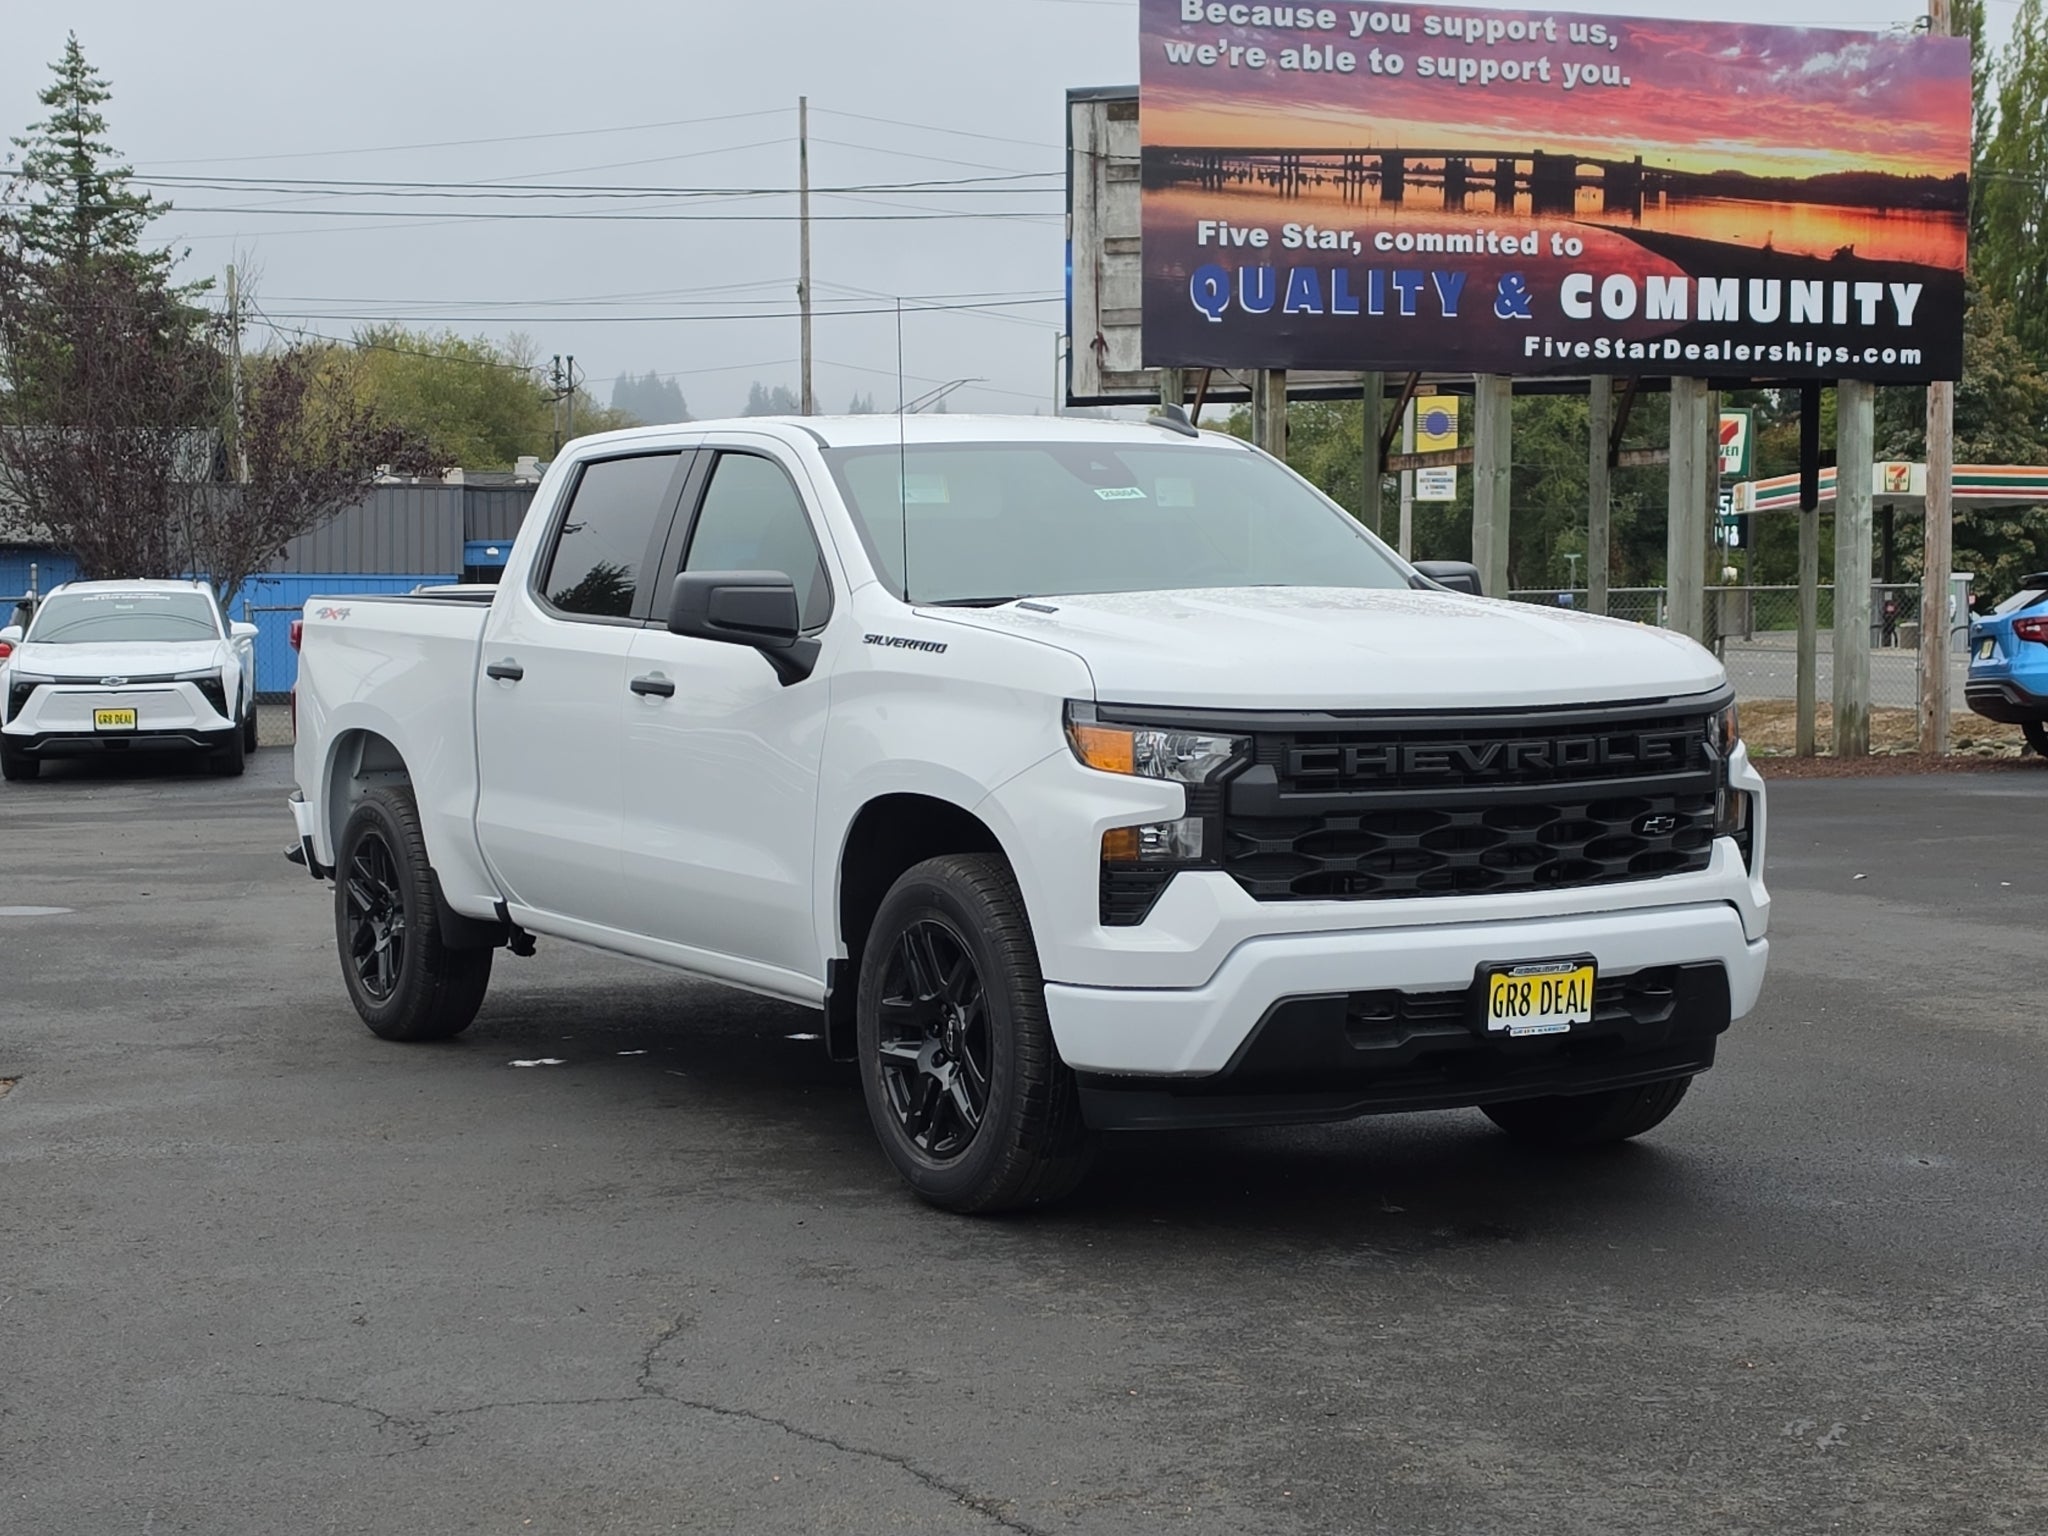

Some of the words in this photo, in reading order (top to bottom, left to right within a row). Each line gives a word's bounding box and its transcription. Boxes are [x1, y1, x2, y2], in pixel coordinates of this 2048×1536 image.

[1181, 0, 1337, 30] Because
[1349, 11, 1411, 38] you
[1423, 16, 1556, 45] support
[1569, 22, 1618, 50] us,
[1164, 39, 1267, 67] we're
[1279, 43, 1357, 73] able
[1368, 47, 1405, 75] to
[1416, 55, 1551, 85] support
[1562, 61, 1631, 90] you.
[1198, 220, 1270, 248] Five
[1281, 222, 1362, 256] Star,
[1374, 228, 1539, 256] commited
[1550, 231, 1584, 257] to
[1190, 264, 1467, 322] QUALITY
[1494, 271, 1533, 319] &
[1560, 273, 1923, 326] COMMUNITY
[1524, 336, 1921, 367] FiveStarDealerships.com
[862, 634, 948, 654] SILVERADO
[1290, 729, 1704, 777] CHEVROLET
[1493, 982, 1531, 1018] GR8
[1540, 979, 1588, 1015] DEAL
